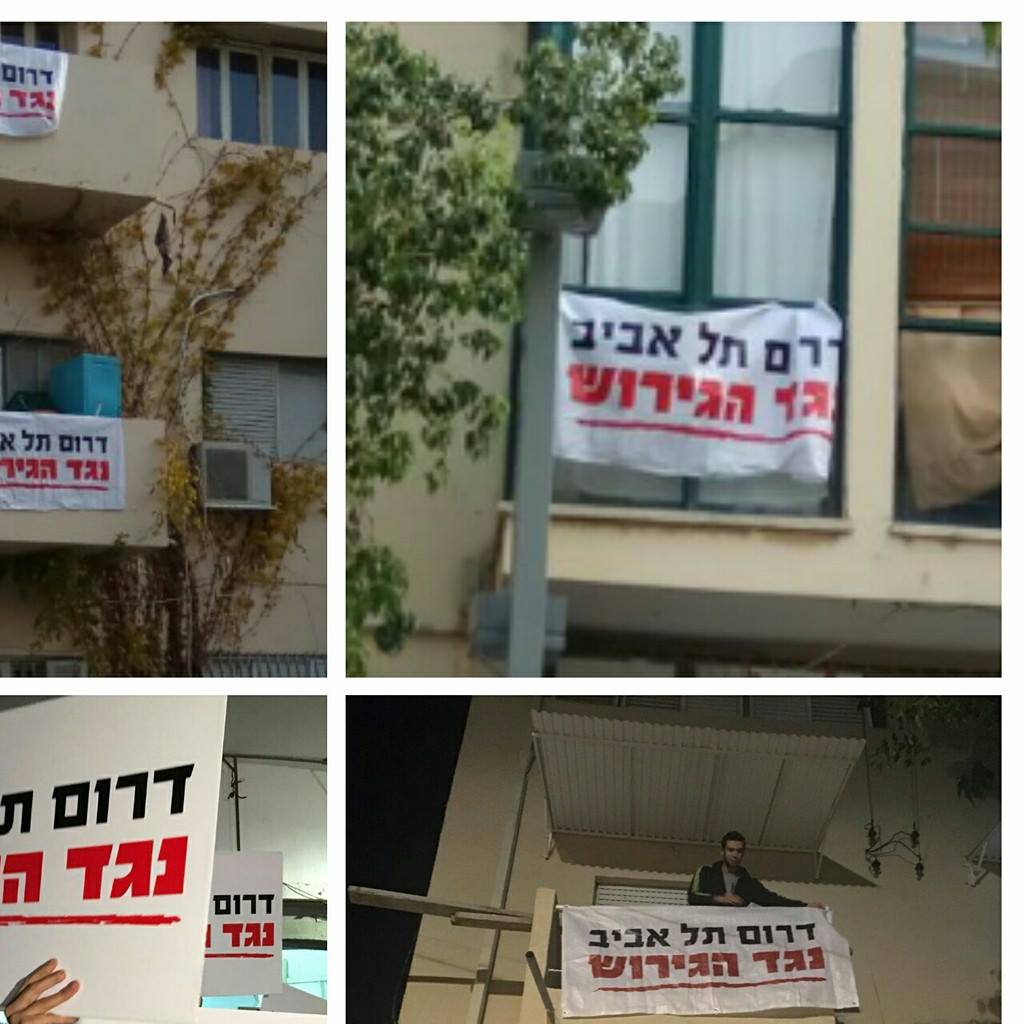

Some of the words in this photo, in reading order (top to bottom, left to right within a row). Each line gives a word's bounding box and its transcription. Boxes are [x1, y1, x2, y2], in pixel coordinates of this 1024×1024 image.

[1, 64, 53, 85] דרום
[570, 321, 682, 358] אביב
[699, 322, 747, 368] תל
[567, 362, 756, 424] הגירוש
[22, 430, 51, 451] תל
[59, 435, 107, 453] דרום
[67, 459, 109, 480] נגד
[52, 764, 194, 829] דרום
[67, 836, 187, 900] נגד
[213, 894, 274, 915] דרום
[223, 923, 274, 947] נגד
[589, 929, 670, 948] אביב
[680, 923, 725, 946] תל
[737, 923, 815, 944] דרום
[587, 952, 739, 979] הגירוש
[752, 947, 825, 973] נגד
